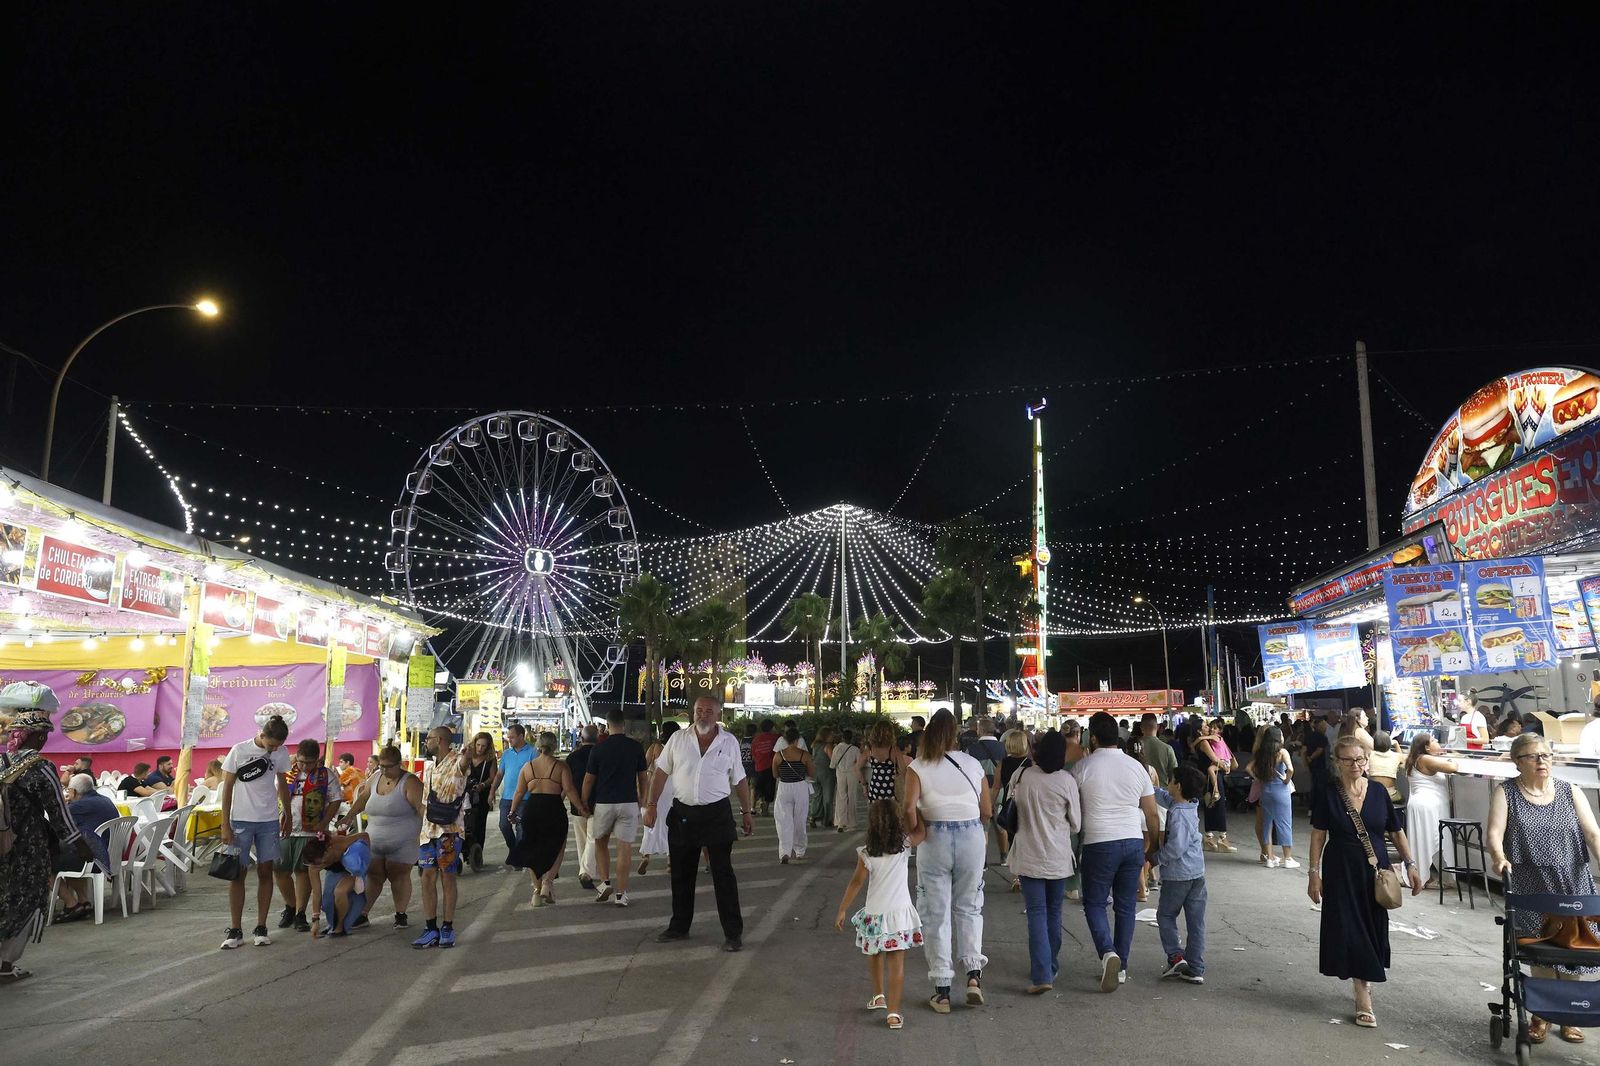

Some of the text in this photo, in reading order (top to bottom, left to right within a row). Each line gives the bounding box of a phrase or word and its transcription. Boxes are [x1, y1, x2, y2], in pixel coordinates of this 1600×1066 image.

[1510, 372, 1566, 390] LA FRONTERA
[39, 565, 93, 590] de CORDERO
[1477, 564, 1532, 578] OFERTA
[124, 585, 166, 607] de TERNERA
